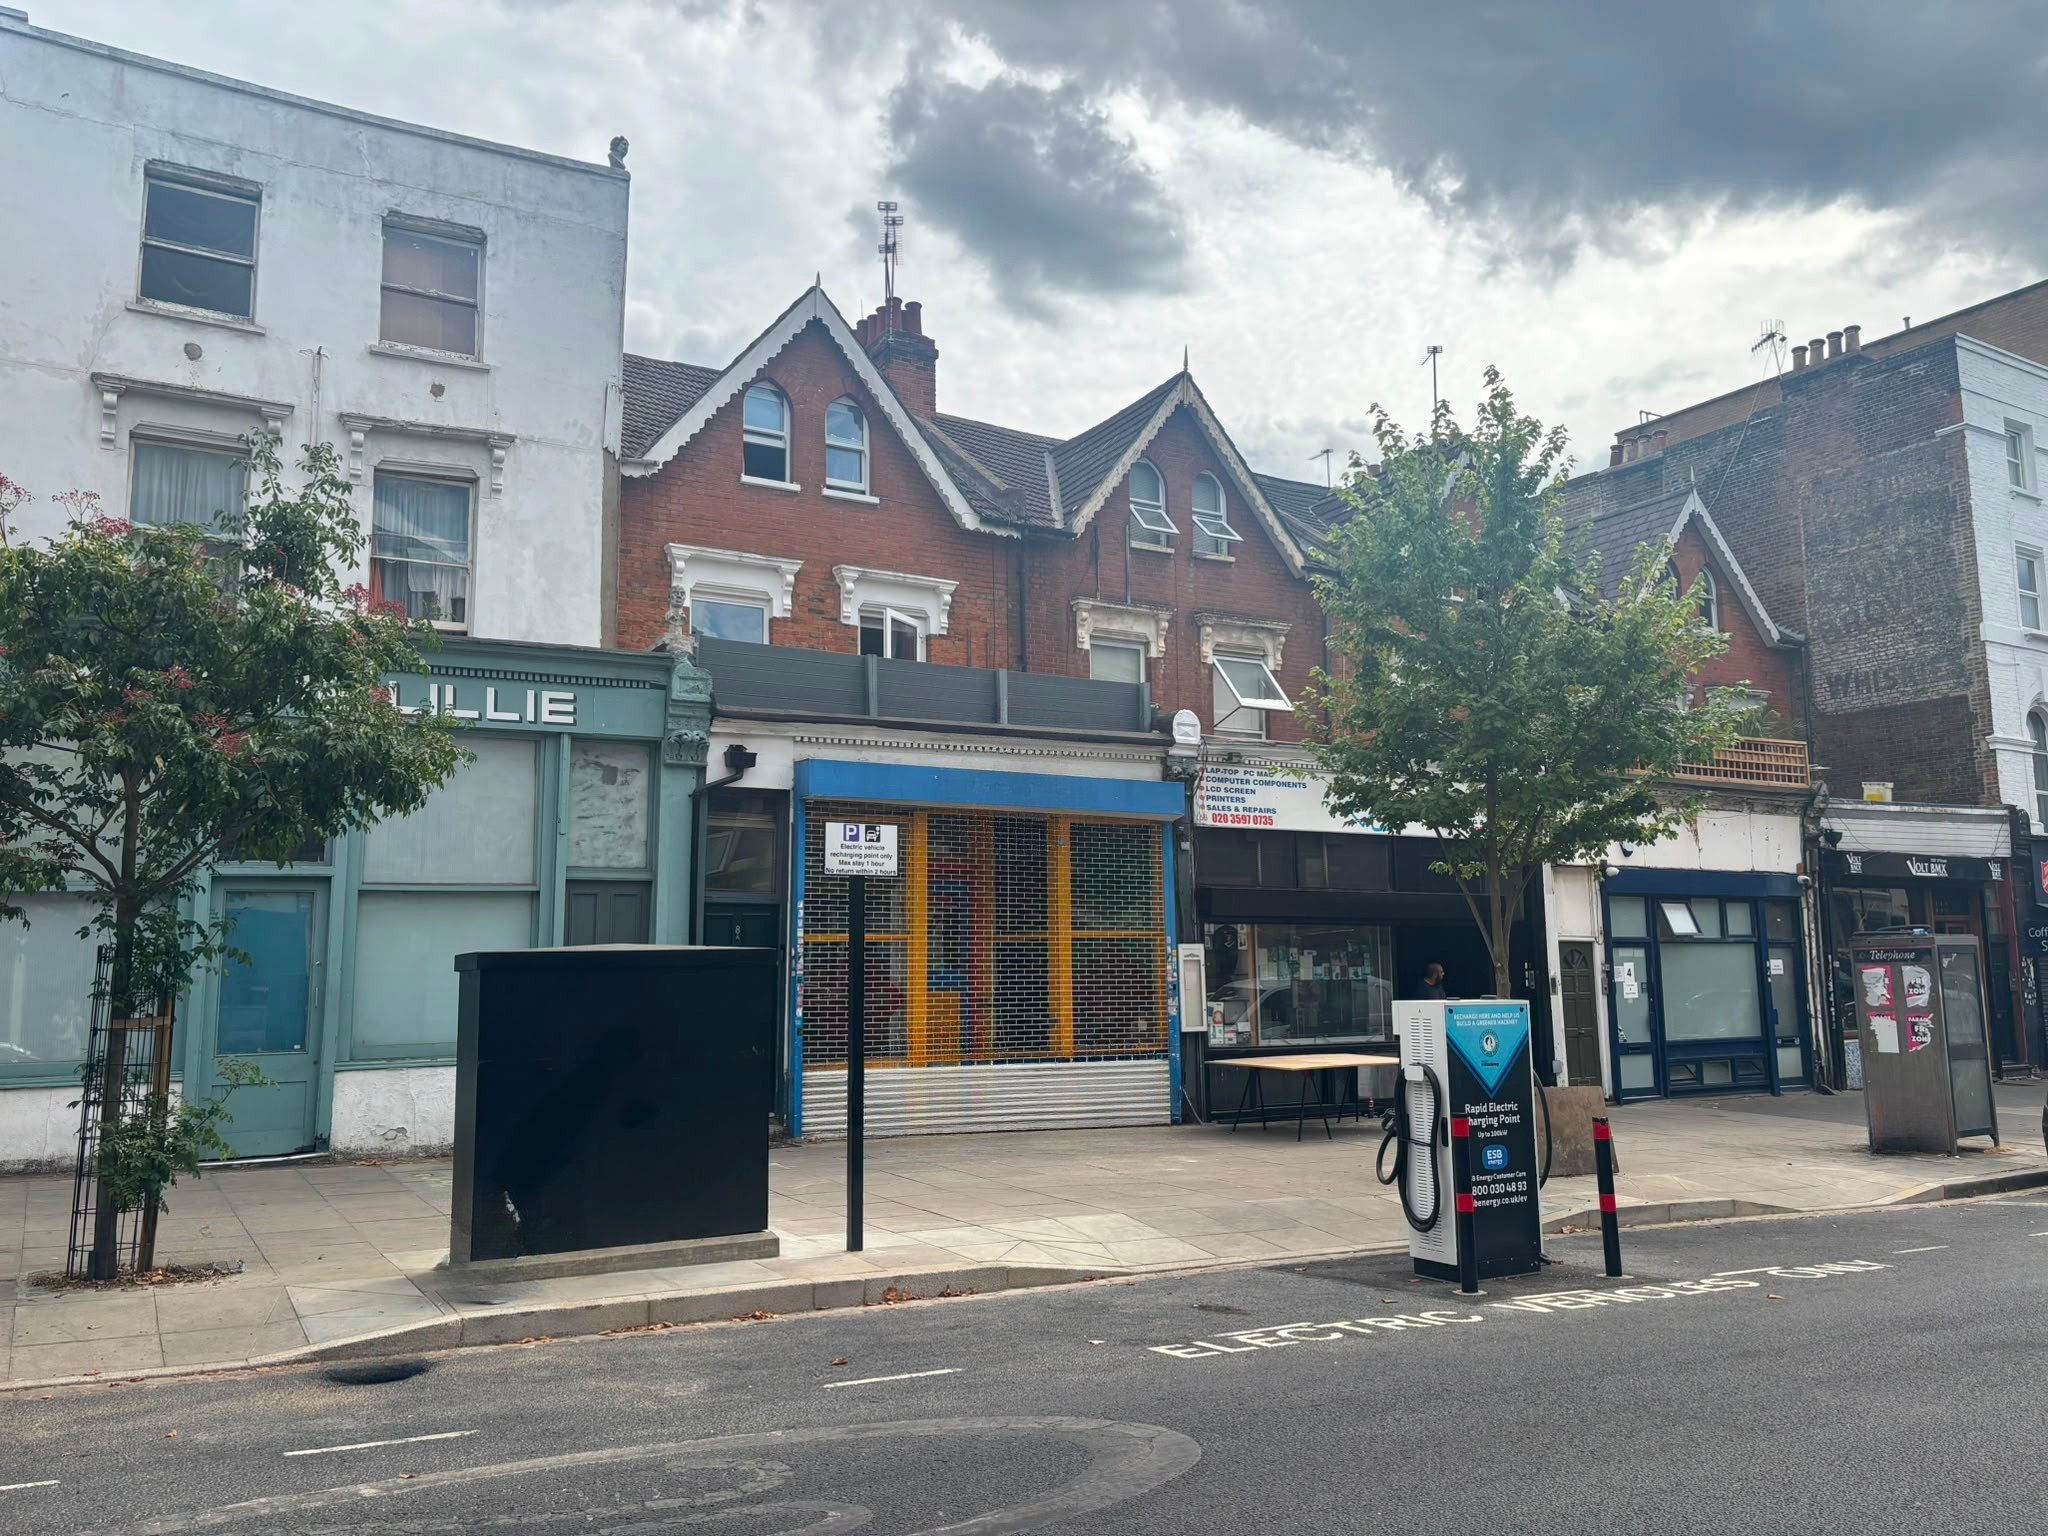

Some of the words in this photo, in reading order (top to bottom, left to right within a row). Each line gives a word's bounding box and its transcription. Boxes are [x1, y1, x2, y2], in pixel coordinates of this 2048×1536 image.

[1205, 776, 1251, 786] COMPUTER
[1252, 780, 1307, 789] COMPONENTS
[1223, 787, 1256, 795] SCREEN
[1205, 795, 1246, 804] PRINTERS
[1206, 804, 1232, 812] SALES
[1242, 806, 1277, 814] REPAIRS
[1211, 813, 1229, 824] 020
[1230, 814, 1251, 825] 3597
[1252, 815, 1274, 826] 0735
[830, 851, 863, 860] recharging
[1906, 856, 1929, 876] VOLT
[1930, 863, 1948, 874] BMX
[1869, 950, 1916, 960] Telephone
[1465, 1102, 1488, 1115] Rapid
[1488, 1101, 1519, 1112] Electric
[1467, 1115, 1499, 1128] harging
[1499, 1113, 1521, 1124] Point
[1486, 1149, 1503, 1160] ESB
[1476, 1174, 1493, 1182] Energy
[1494, 1172, 1515, 1180] Customer
[1489, 1183, 1505, 1194] 030
[1506, 1182, 1516, 1192] 48
[1517, 1181, 1527, 1191] 93
[1472, 1194, 1528, 1208] benergy.co.uk/ev
[1148, 1311, 1485, 1359] ELECTRIC
[1491, 1278, 1761, 1313] VEHICLES
[1766, 1259, 1894, 1279] ONLY
